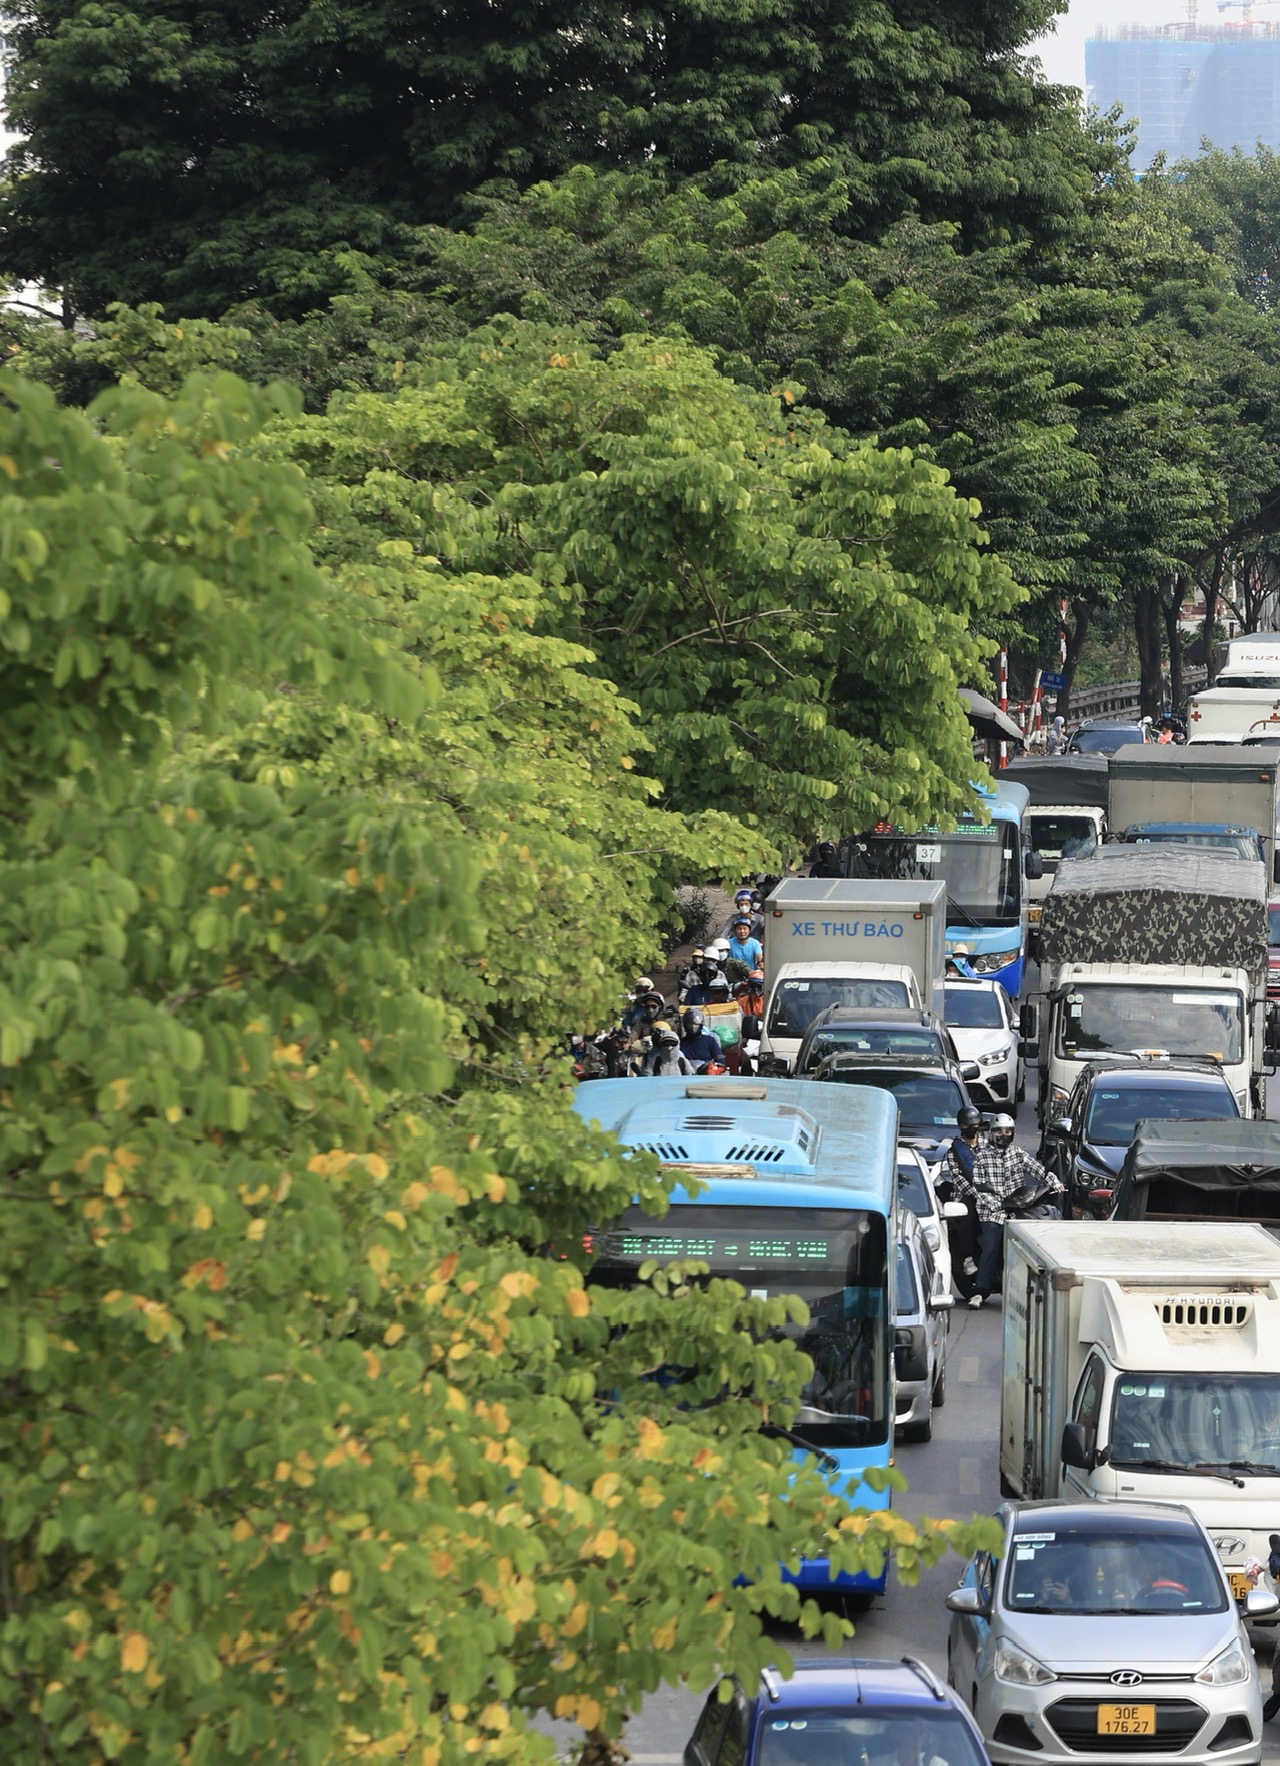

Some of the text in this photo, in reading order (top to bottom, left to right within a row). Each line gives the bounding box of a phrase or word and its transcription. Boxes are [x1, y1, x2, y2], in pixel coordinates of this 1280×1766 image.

[921, 848, 936, 859] 37
[791, 918, 904, 938] XE THƯ BÁO
[1180, 1297, 1235, 1305] HYUNDAI
[1115, 1707, 1139, 1720] 30E
[1105, 1721, 1149, 1733] 176.27
